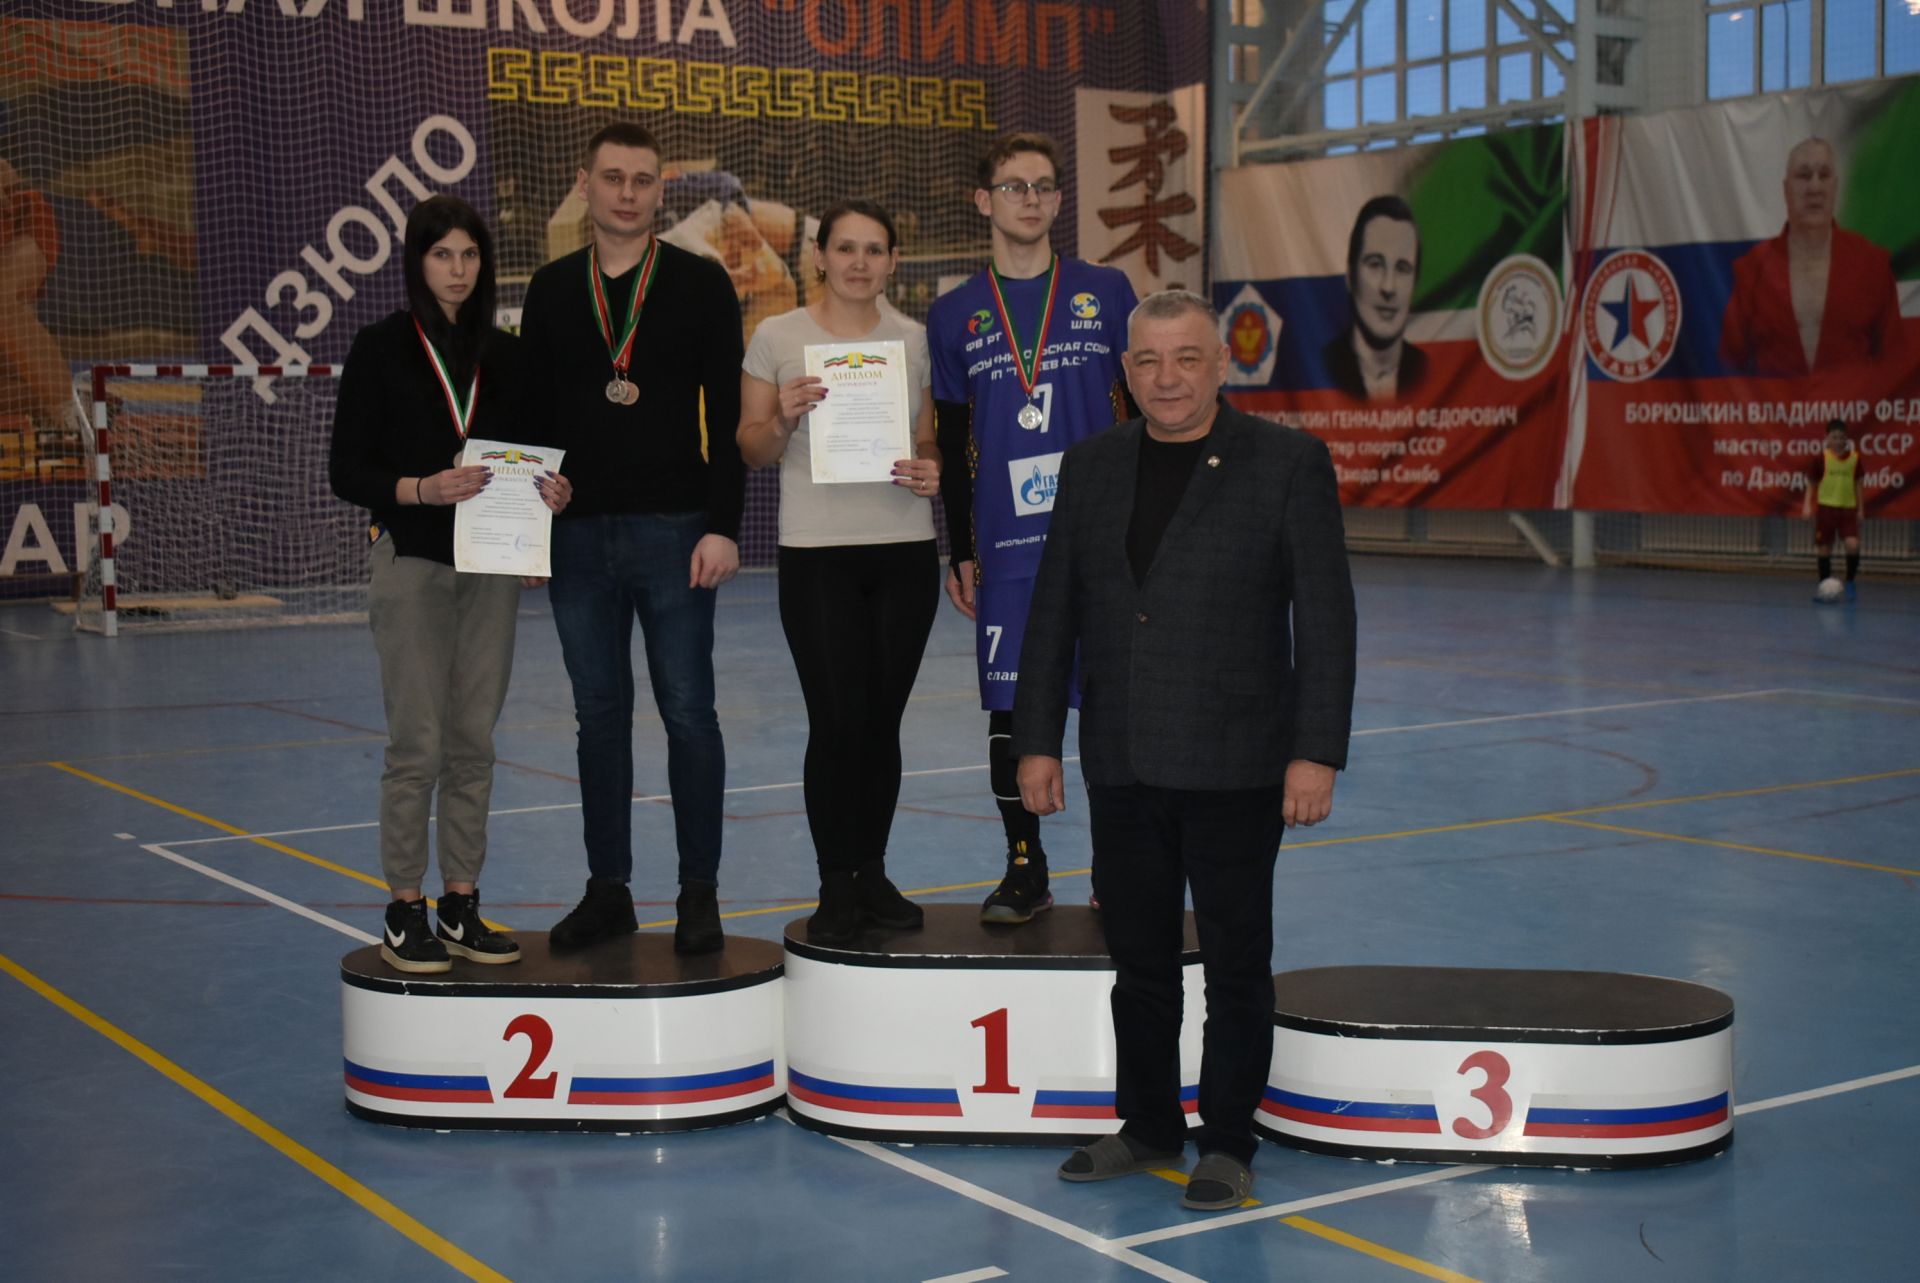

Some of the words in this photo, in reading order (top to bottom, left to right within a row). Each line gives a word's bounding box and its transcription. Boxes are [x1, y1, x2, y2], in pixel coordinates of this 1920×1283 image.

[219, 114, 477, 404] ДЗЮДО
[1071, 320, 1102, 331] ШВЛ
[966, 338, 983, 352] ФВ
[987, 332, 1003, 346] РТ
[1032, 383, 1053, 433] 7
[1332, 405, 1413, 431] ГЕННАДИЙ
[1416, 405, 1518, 430] ФЕДОРОВИЧ
[1625, 402, 1744, 424] БОРЮШКИН
[1750, 399, 1869, 428] ВЛАДИМИР
[1408, 437, 1446, 456] СССР
[1713, 439, 1780, 460] мастер
[1860, 432, 1914, 456] СССР
[492, 465, 535, 477] ИПЛОМ
[1721, 469, 1743, 487] по
[1862, 465, 1904, 489] мбо
[986, 625, 1003, 664] 7
[502, 1013, 558, 1099] 2
[970, 1007, 1020, 1095] 1
[1452, 1049, 1513, 1140] 3
